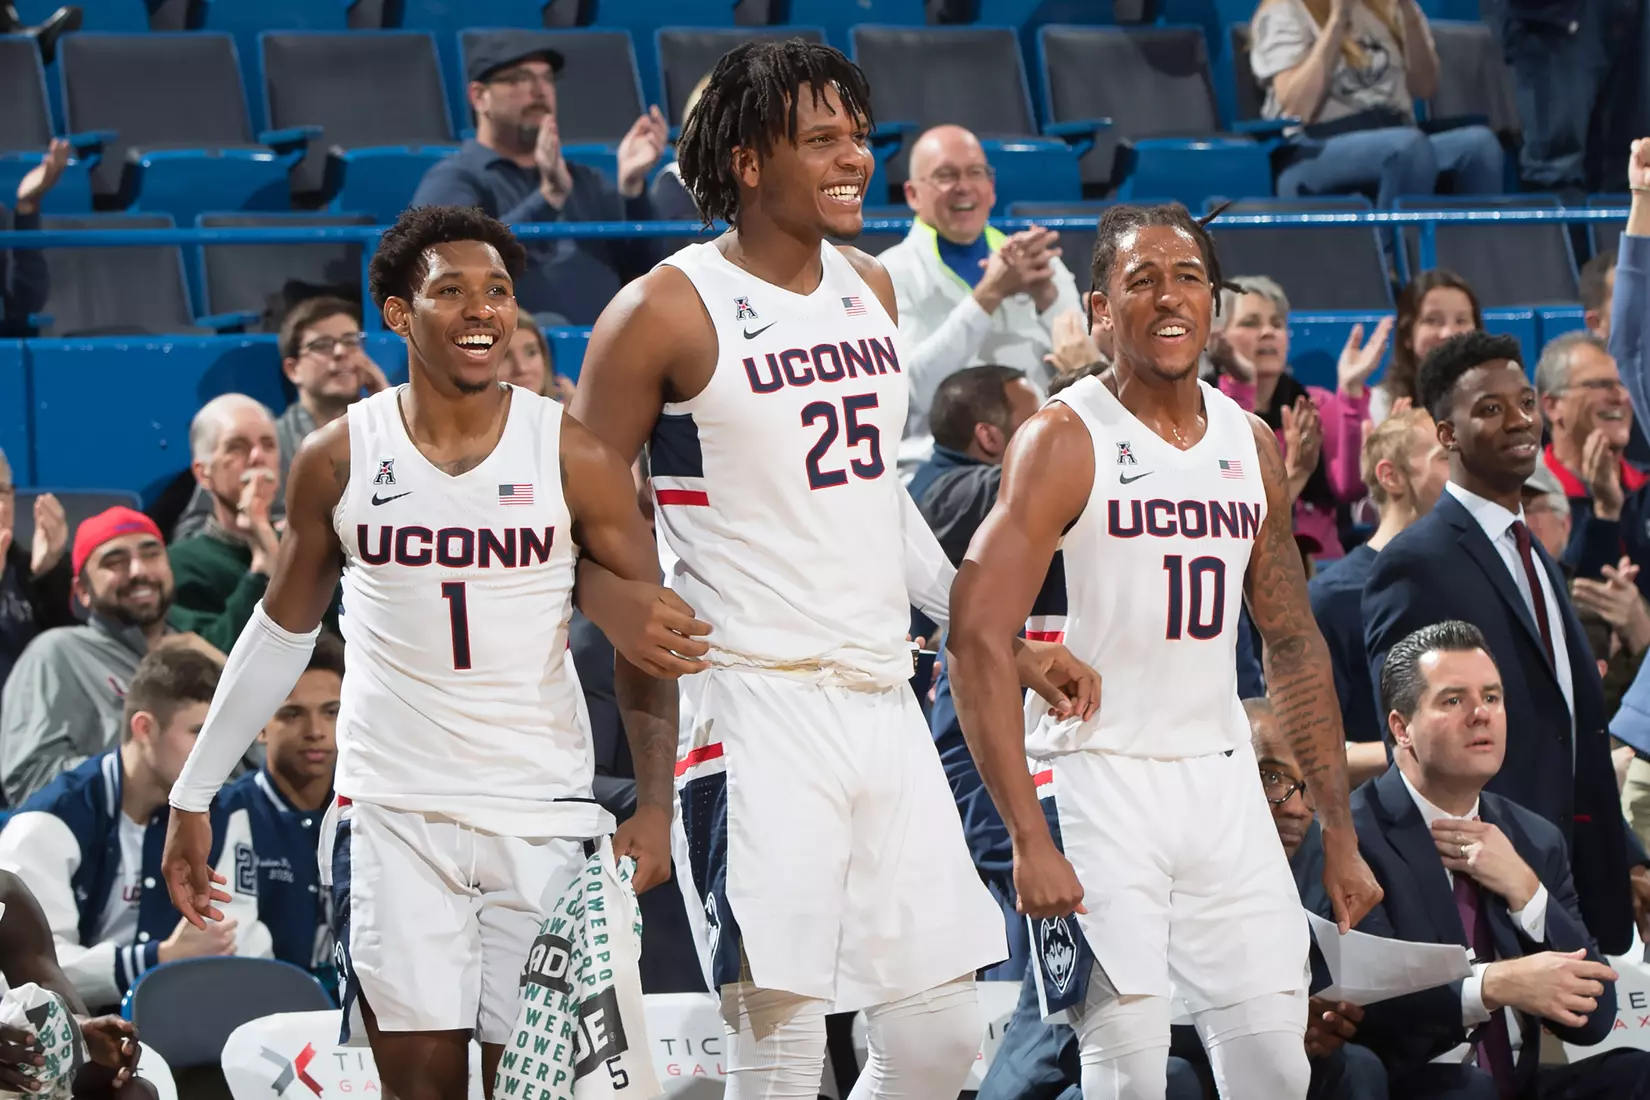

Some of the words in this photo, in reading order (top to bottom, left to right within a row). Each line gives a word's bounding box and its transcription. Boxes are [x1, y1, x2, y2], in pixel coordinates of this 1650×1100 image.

[742, 336, 901, 394] UCONN
[800, 392, 886, 491] 25
[1108, 498, 1261, 540] UCONN
[357, 524, 555, 568] UCONN
[1163, 554, 1226, 641] 10
[441, 581, 472, 670] 1
[520, 943, 569, 980] AD
[332, 1051, 364, 1071] TI
[659, 1037, 722, 1056] TIC
[339, 1079, 378, 1093] GA
[606, 1055, 629, 1090] 5
[667, 1062, 728, 1077] GAL
